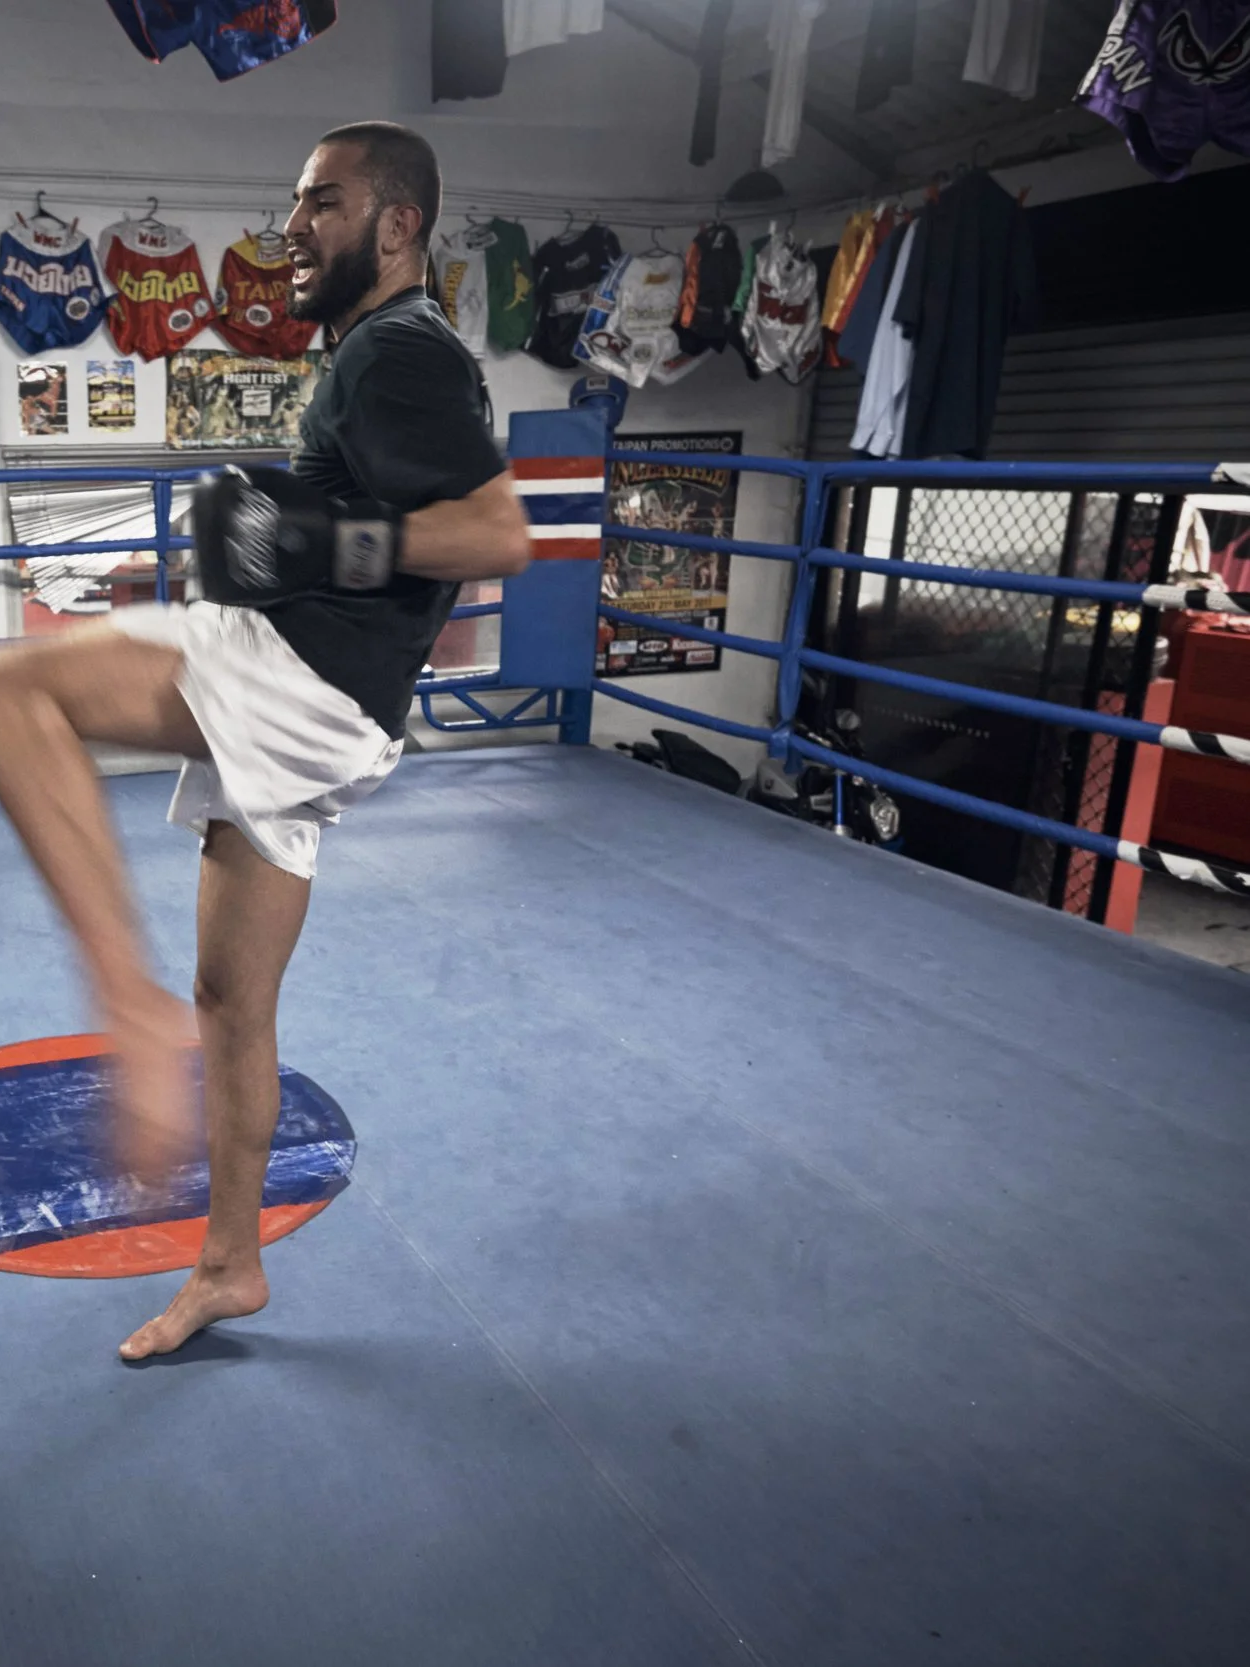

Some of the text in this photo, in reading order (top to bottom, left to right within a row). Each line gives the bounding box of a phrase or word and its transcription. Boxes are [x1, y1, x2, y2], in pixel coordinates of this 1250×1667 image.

[33, 231, 62, 248] WMC
[138, 232, 168, 248] WMC
[2, 256, 94, 296] มวยไทย
[234, 279, 287, 301] TAIP
[261, 373, 289, 384] FEST
[650, 438, 721, 451] PROMOTIONS
[674, 599, 691, 609] MAY
